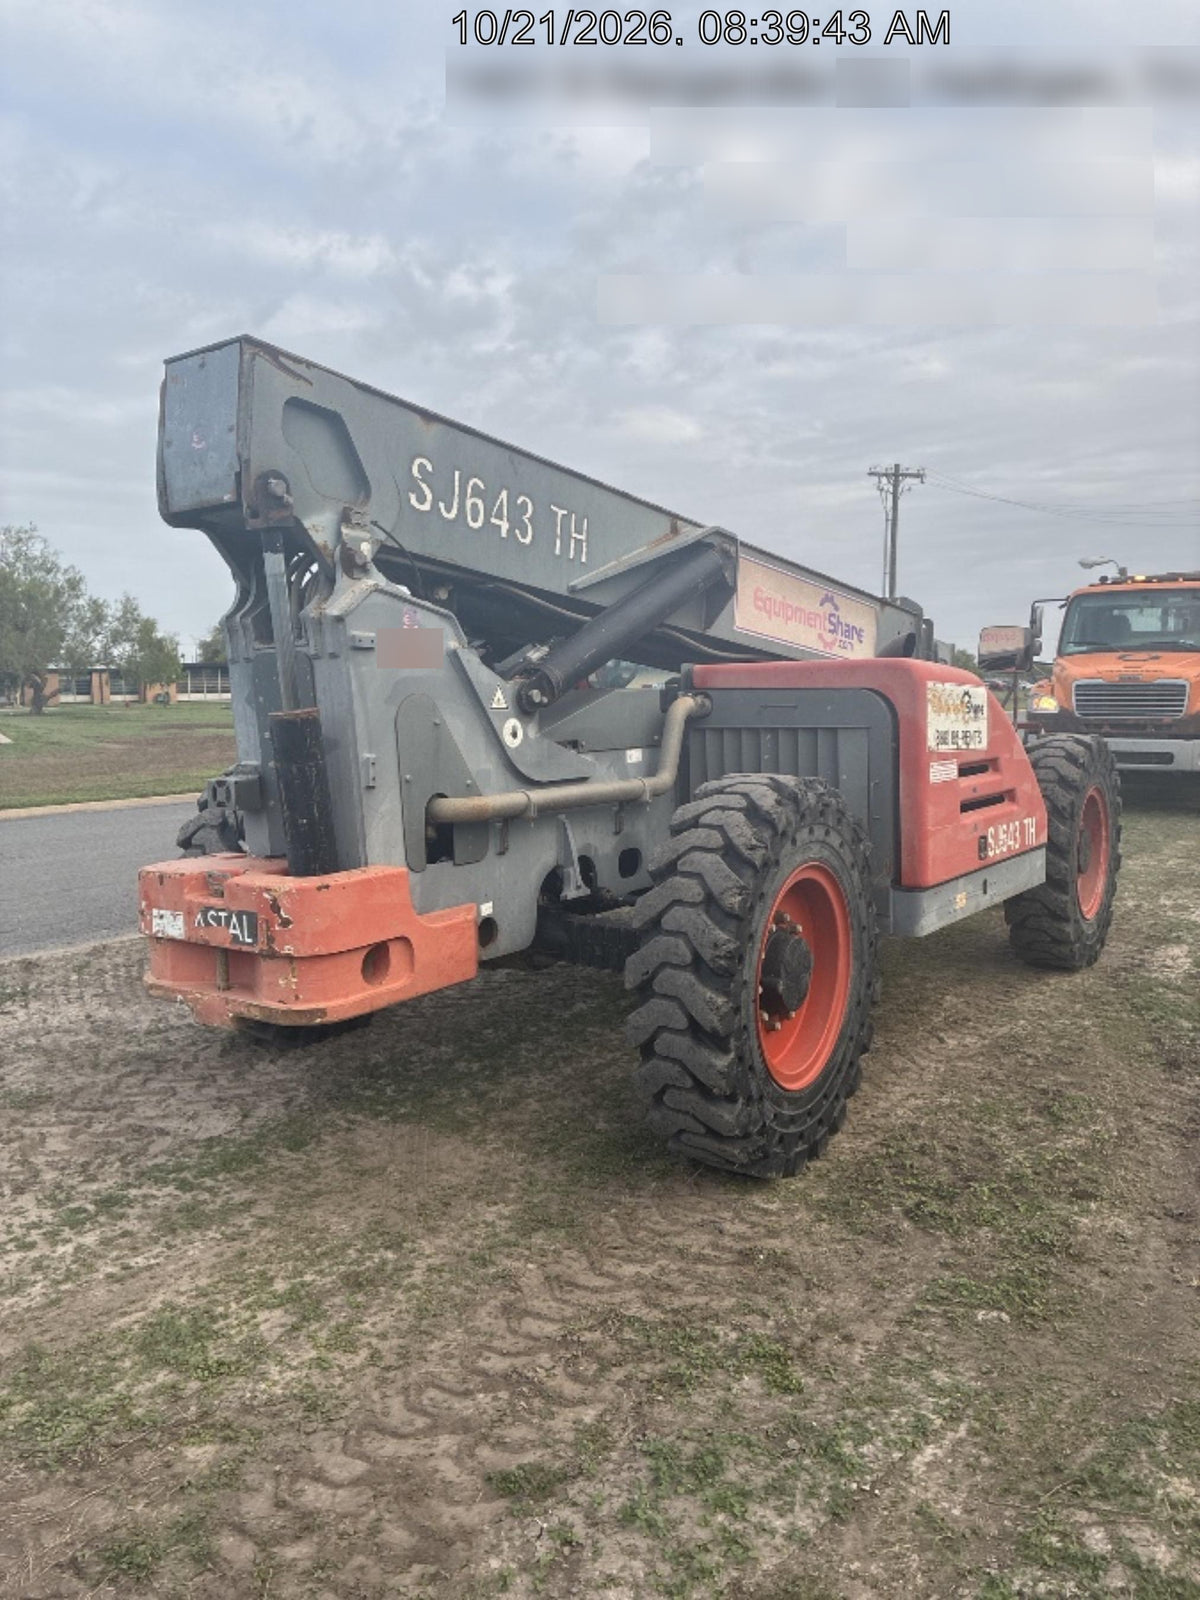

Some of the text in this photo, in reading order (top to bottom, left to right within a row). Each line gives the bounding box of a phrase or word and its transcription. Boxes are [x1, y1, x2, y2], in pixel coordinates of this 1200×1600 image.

[408, 457, 589, 563] SJ643 TH
[753, 587, 865, 643] EquipmentShare
[1023, 816, 1036, 846] TH
